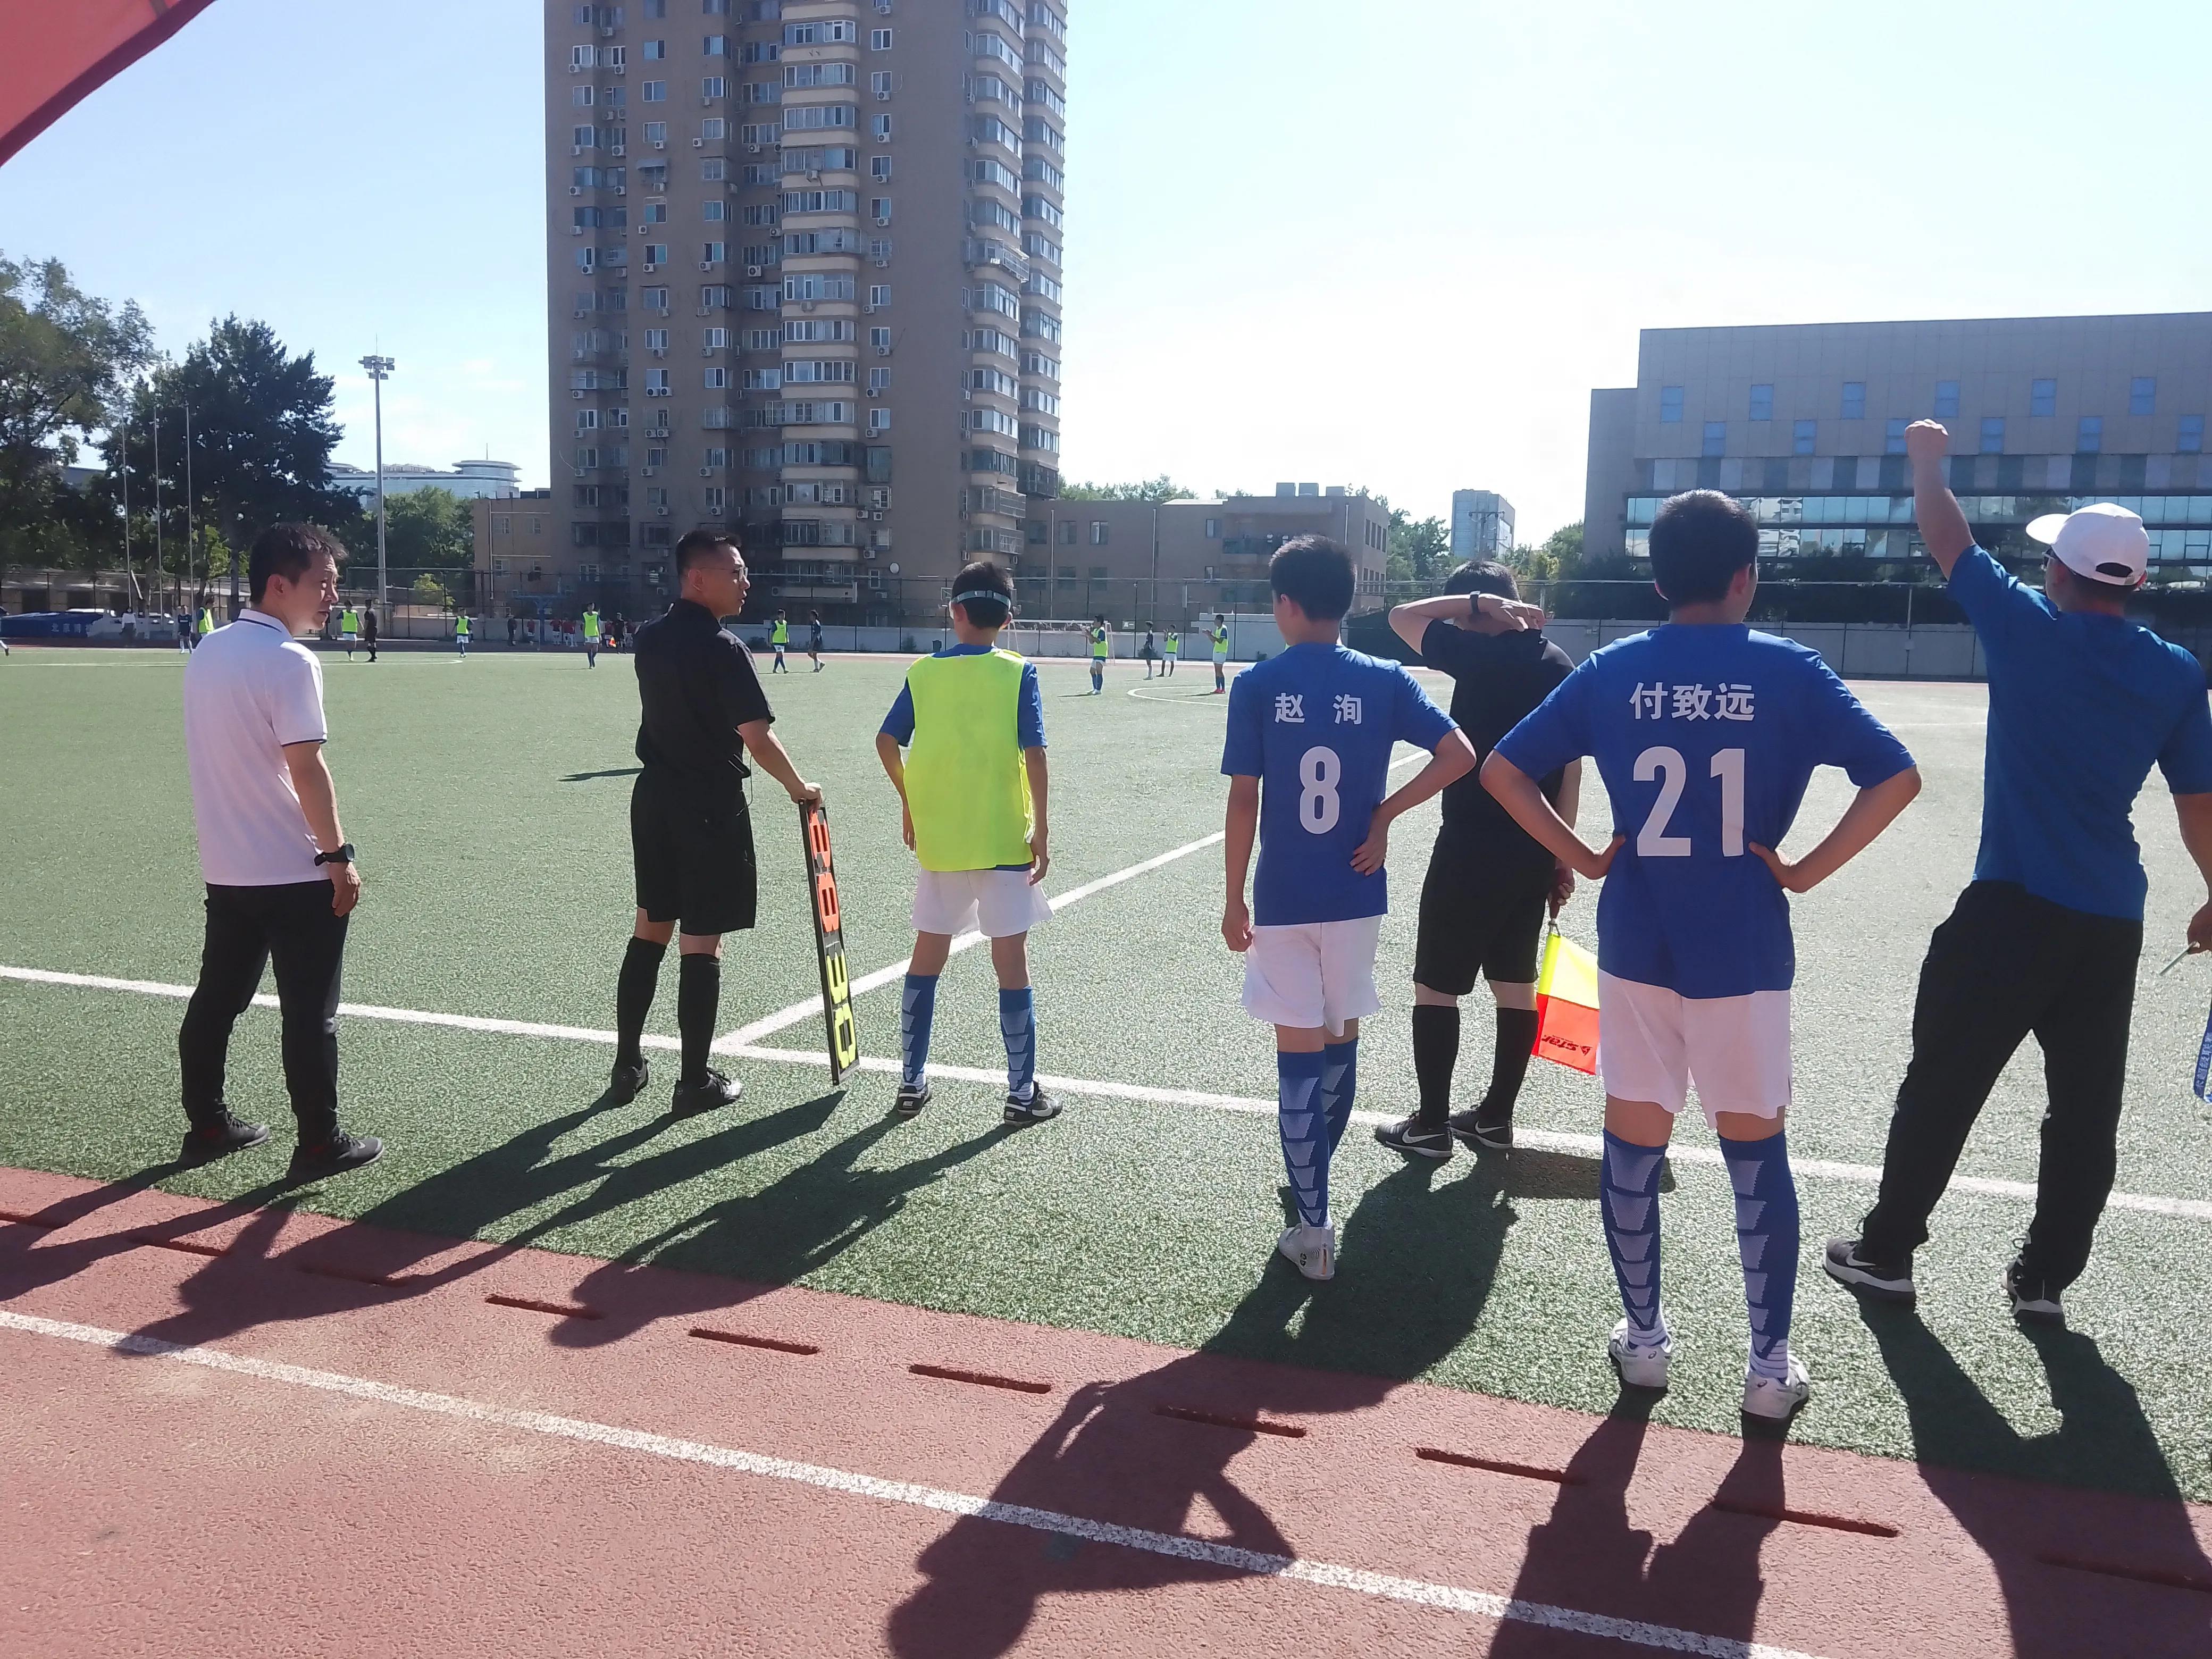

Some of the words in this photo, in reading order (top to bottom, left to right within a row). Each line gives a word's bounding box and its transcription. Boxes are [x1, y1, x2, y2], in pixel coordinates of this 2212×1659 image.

[1629, 682, 1755, 722] 付致远
[1300, 745, 1341, 834] 8
[1633, 746, 1745, 857] 21
